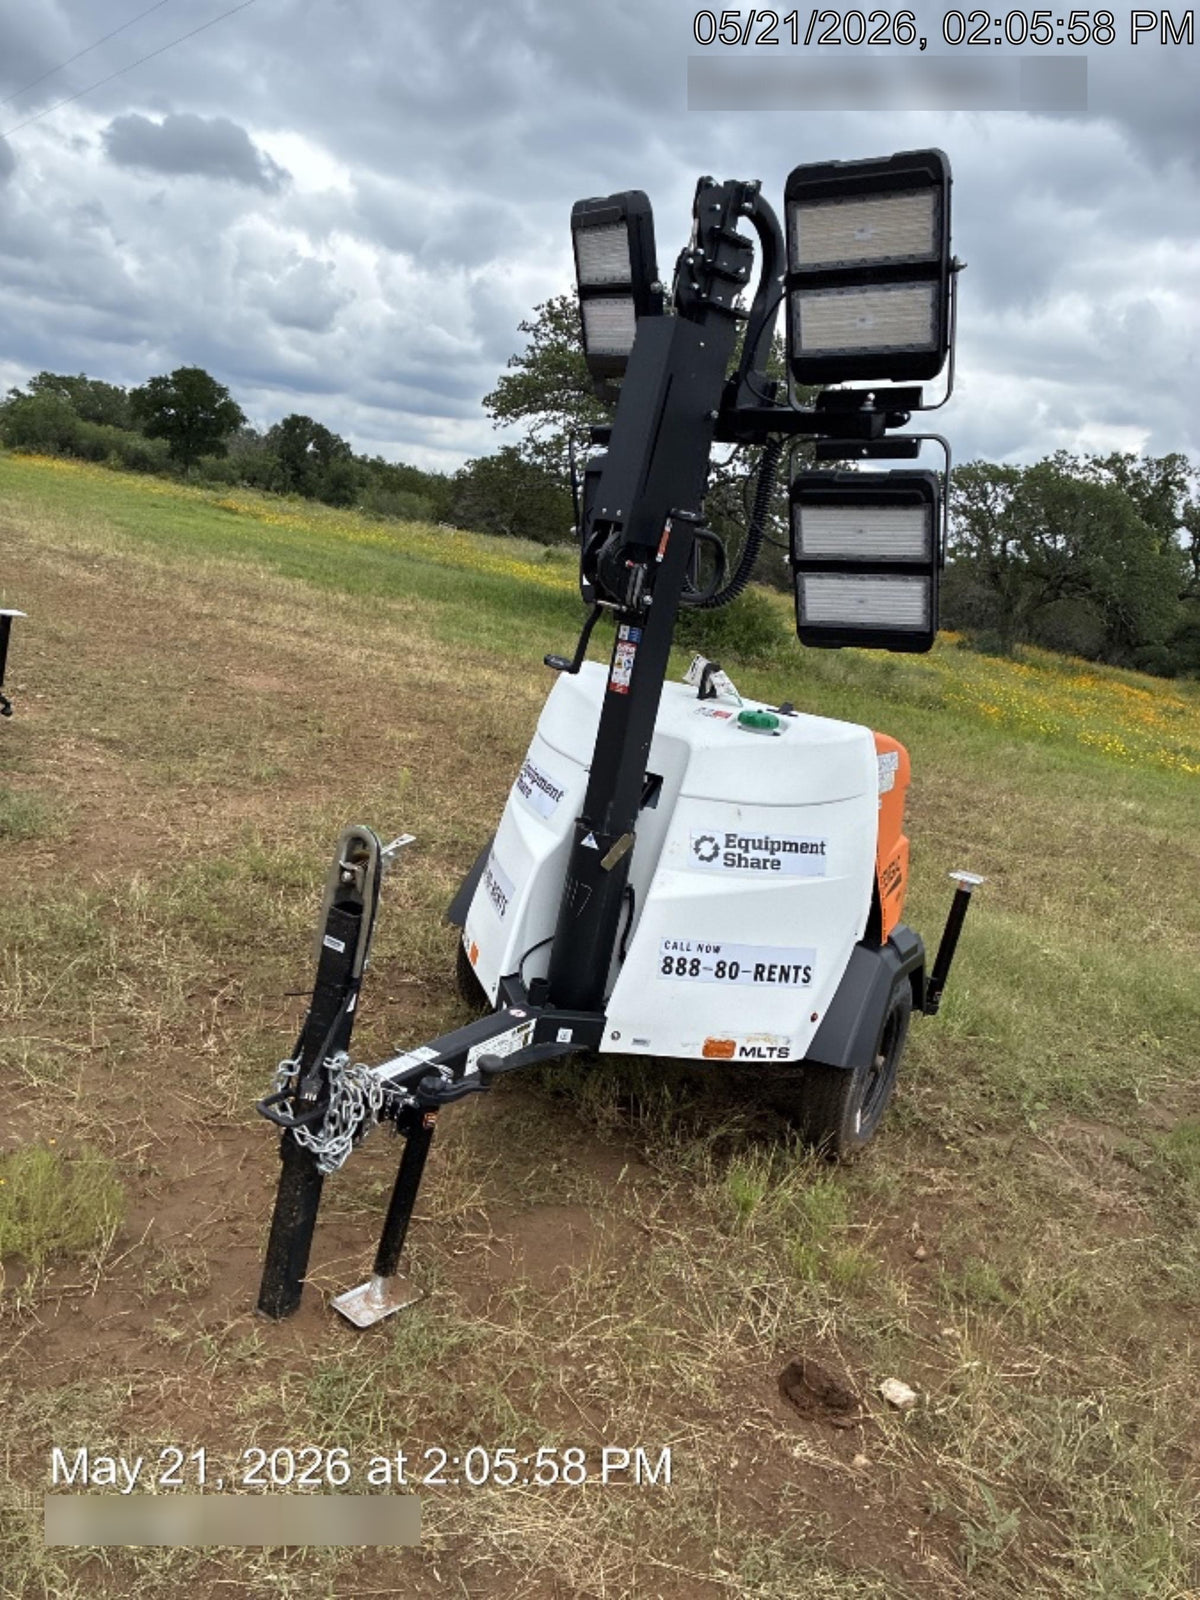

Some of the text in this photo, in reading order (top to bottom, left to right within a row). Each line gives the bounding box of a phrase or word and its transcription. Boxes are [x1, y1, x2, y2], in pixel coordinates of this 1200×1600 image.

[724, 833, 827, 857] Equipment
[722, 852, 782, 871] Share
[664, 940, 722, 954] CALL NOW
[661, 956, 813, 985] 888-80-RENTS
[738, 1046, 791, 1059] MLTS
